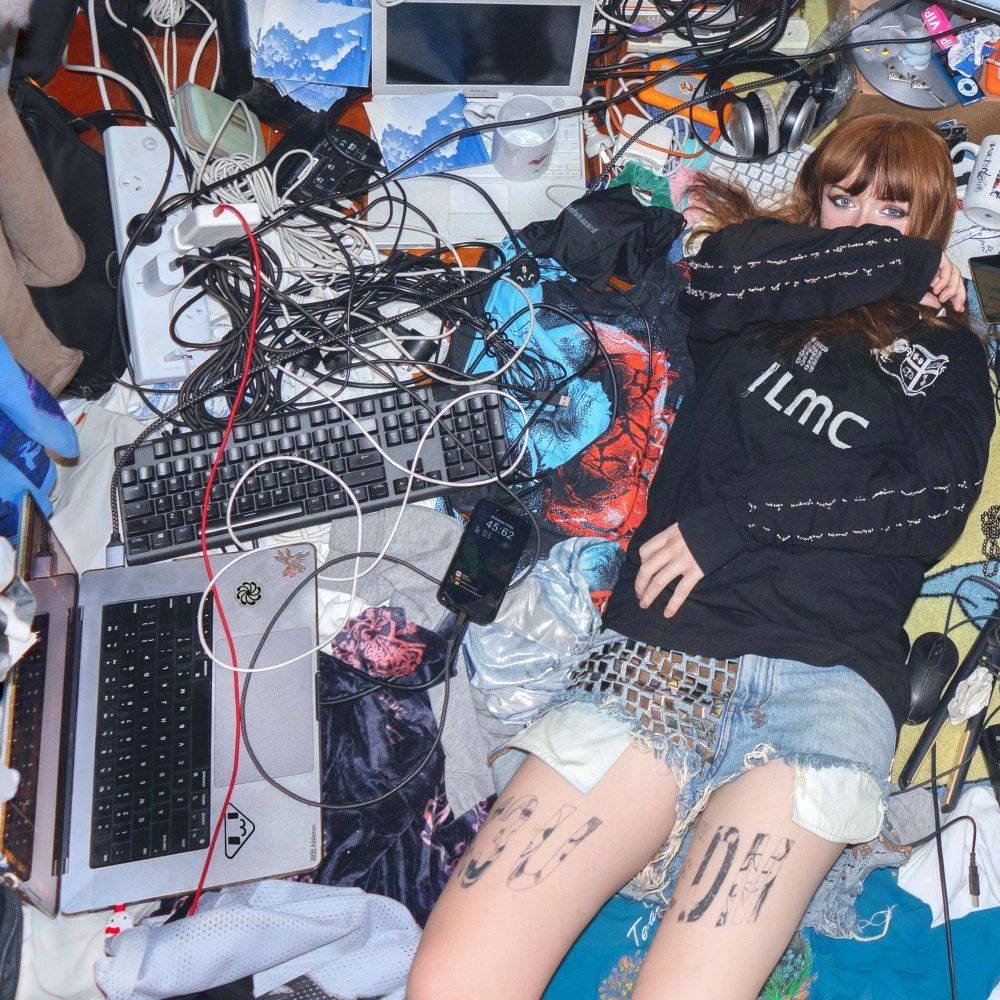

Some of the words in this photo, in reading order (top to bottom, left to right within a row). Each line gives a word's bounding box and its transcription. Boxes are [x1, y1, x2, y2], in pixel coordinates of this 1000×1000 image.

[923, 10, 942, 32] VIP
[566, 204, 599, 234] infohazard
[485, 519, 515, 540] 45:62
[309, 823, 319, 851] Ableton
